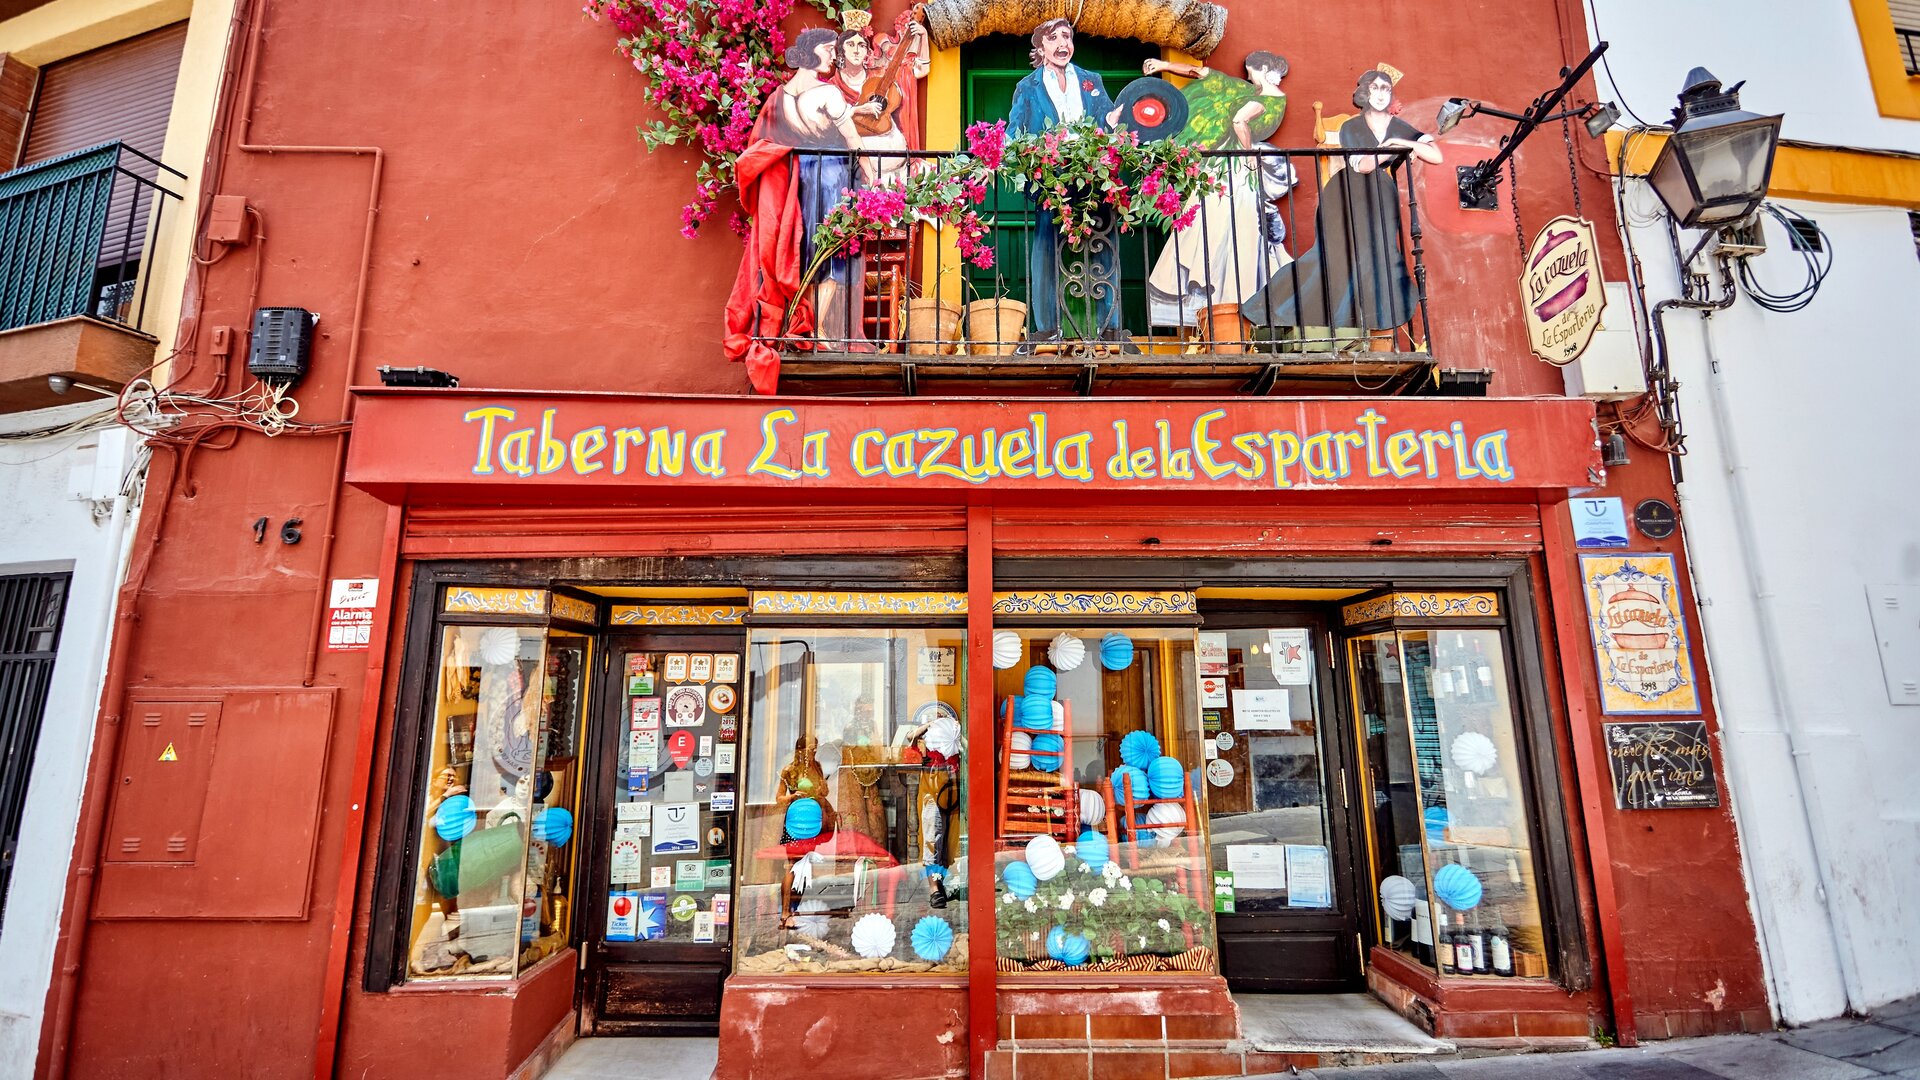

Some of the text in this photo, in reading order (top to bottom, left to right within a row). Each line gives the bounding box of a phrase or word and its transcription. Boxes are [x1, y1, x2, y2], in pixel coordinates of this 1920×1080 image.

[1563, 342, 1578, 357] 1998
[747, 407, 830, 481] La
[850, 411, 1094, 484] cazuela
[332, 609, 372, 620] Alarma
[1638, 651, 1649, 661] de
[1640, 681, 1658, 691] 1998
[678, 736, 686, 747] E
